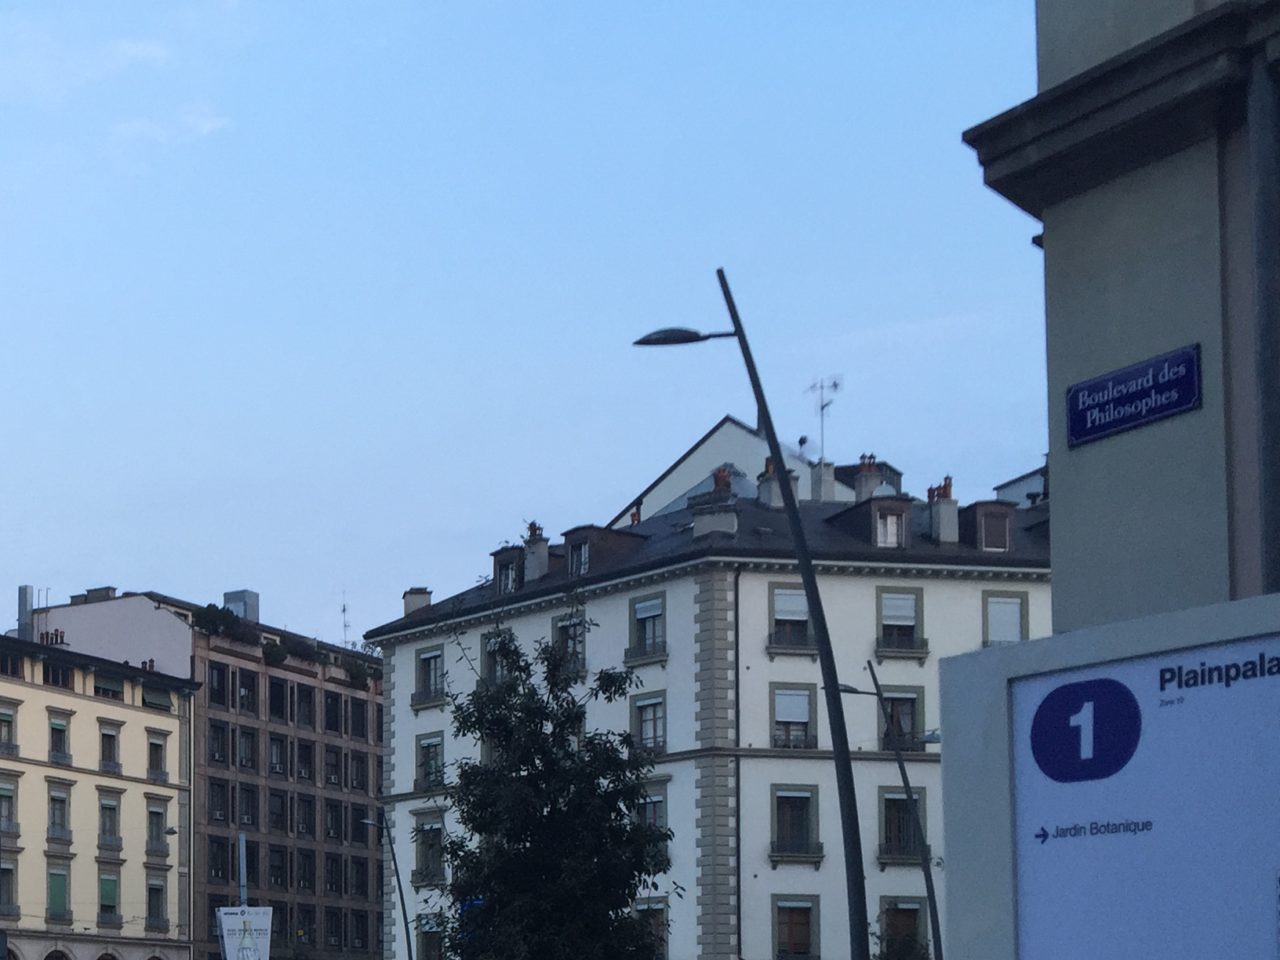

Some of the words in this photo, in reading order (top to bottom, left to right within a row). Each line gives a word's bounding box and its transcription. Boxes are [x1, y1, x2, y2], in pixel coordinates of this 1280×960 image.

[1078, 368, 1154, 411] Boulevard
[1158, 361, 1187, 384] des
[1086, 388, 1179, 429] Philosophes
[1160, 652, 1280, 692] Plainpala
[1070, 701, 1095, 760] 1
[1052, 824, 1087, 840] Jardin
[1090, 820, 1153, 836] Botanique
